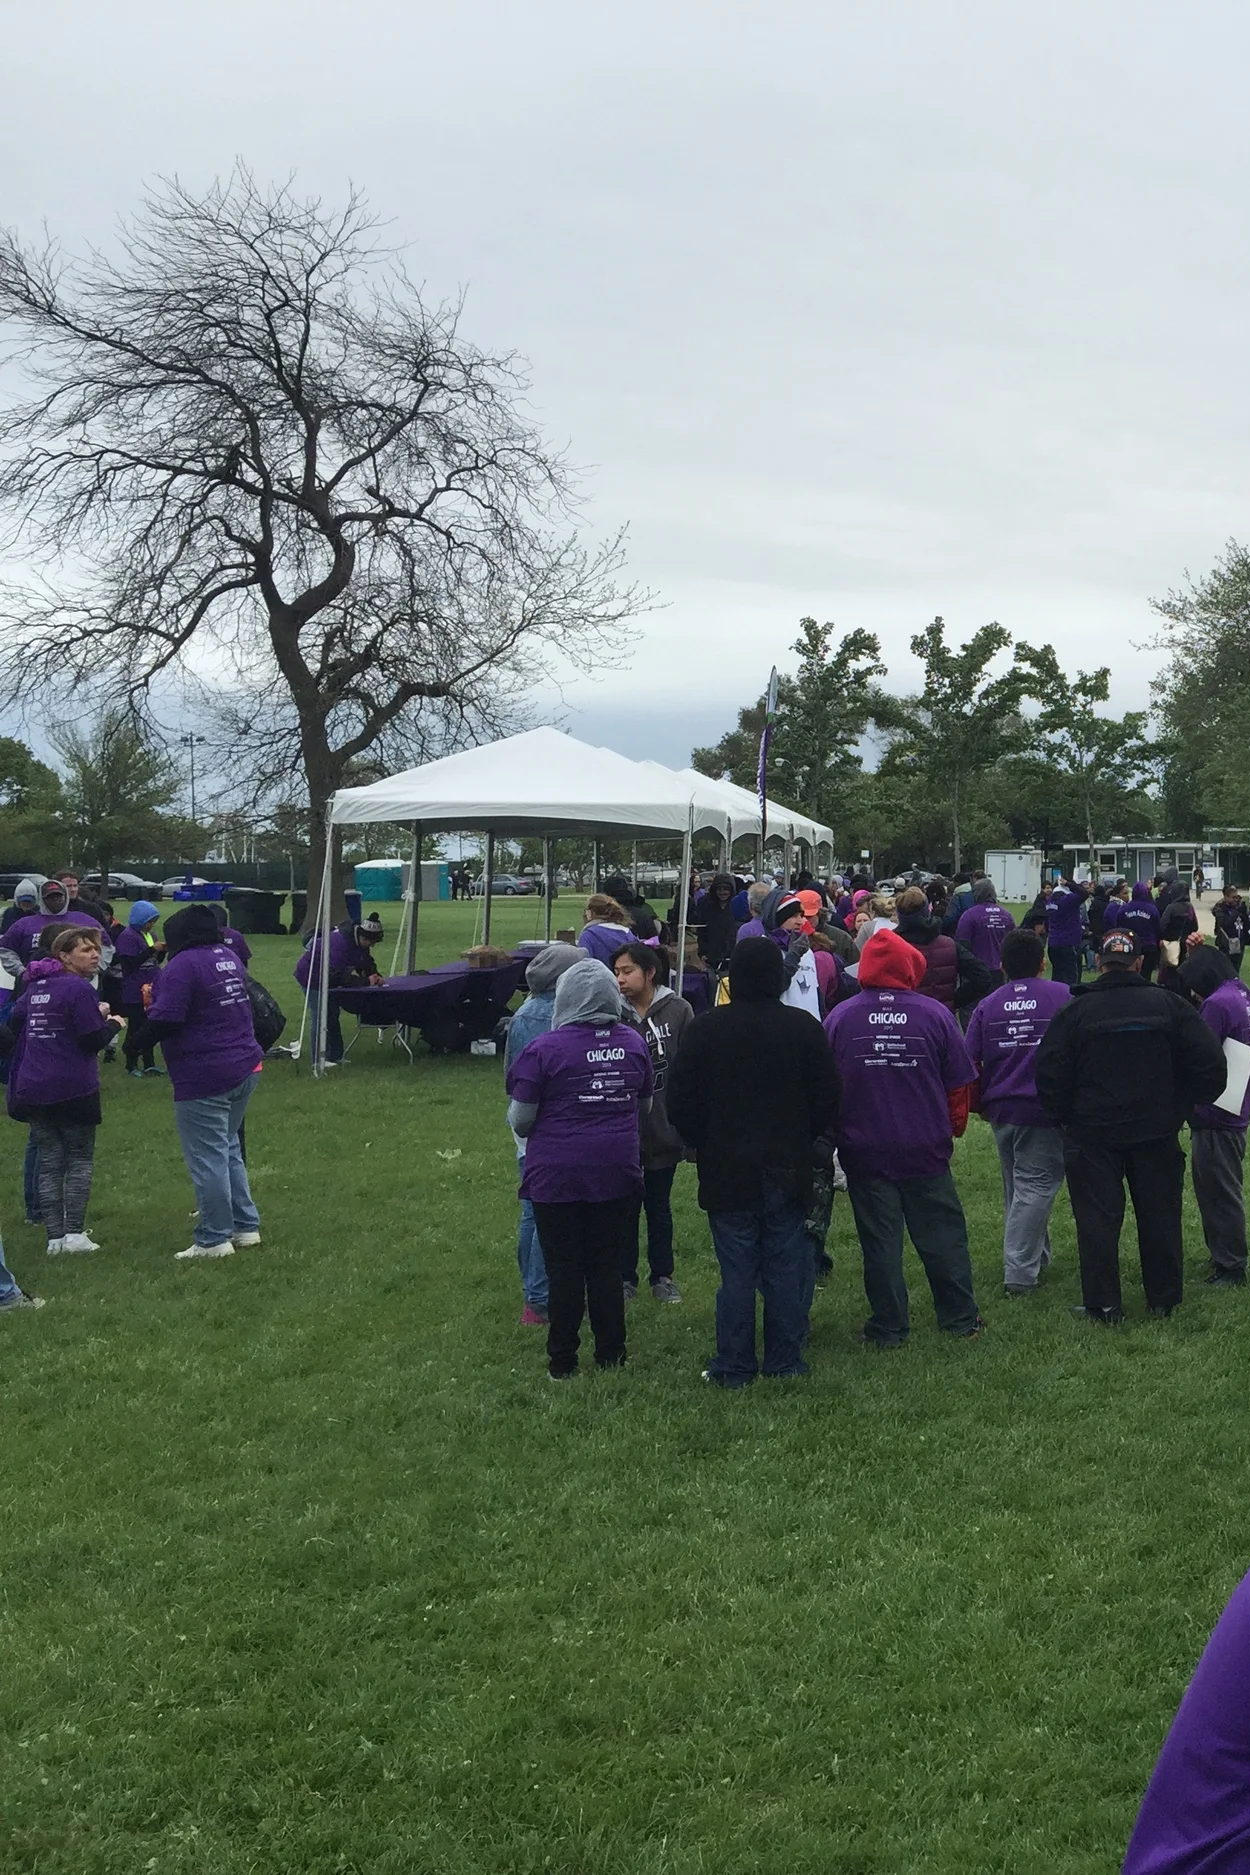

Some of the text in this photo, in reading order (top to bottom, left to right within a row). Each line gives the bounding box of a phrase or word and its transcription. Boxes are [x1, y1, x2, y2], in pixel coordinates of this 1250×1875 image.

[1004, 999, 1037, 1011] CHICAGO
[868, 1012, 908, 1025] CHICAGO
[586, 1048, 626, 1062] CHICAGO
